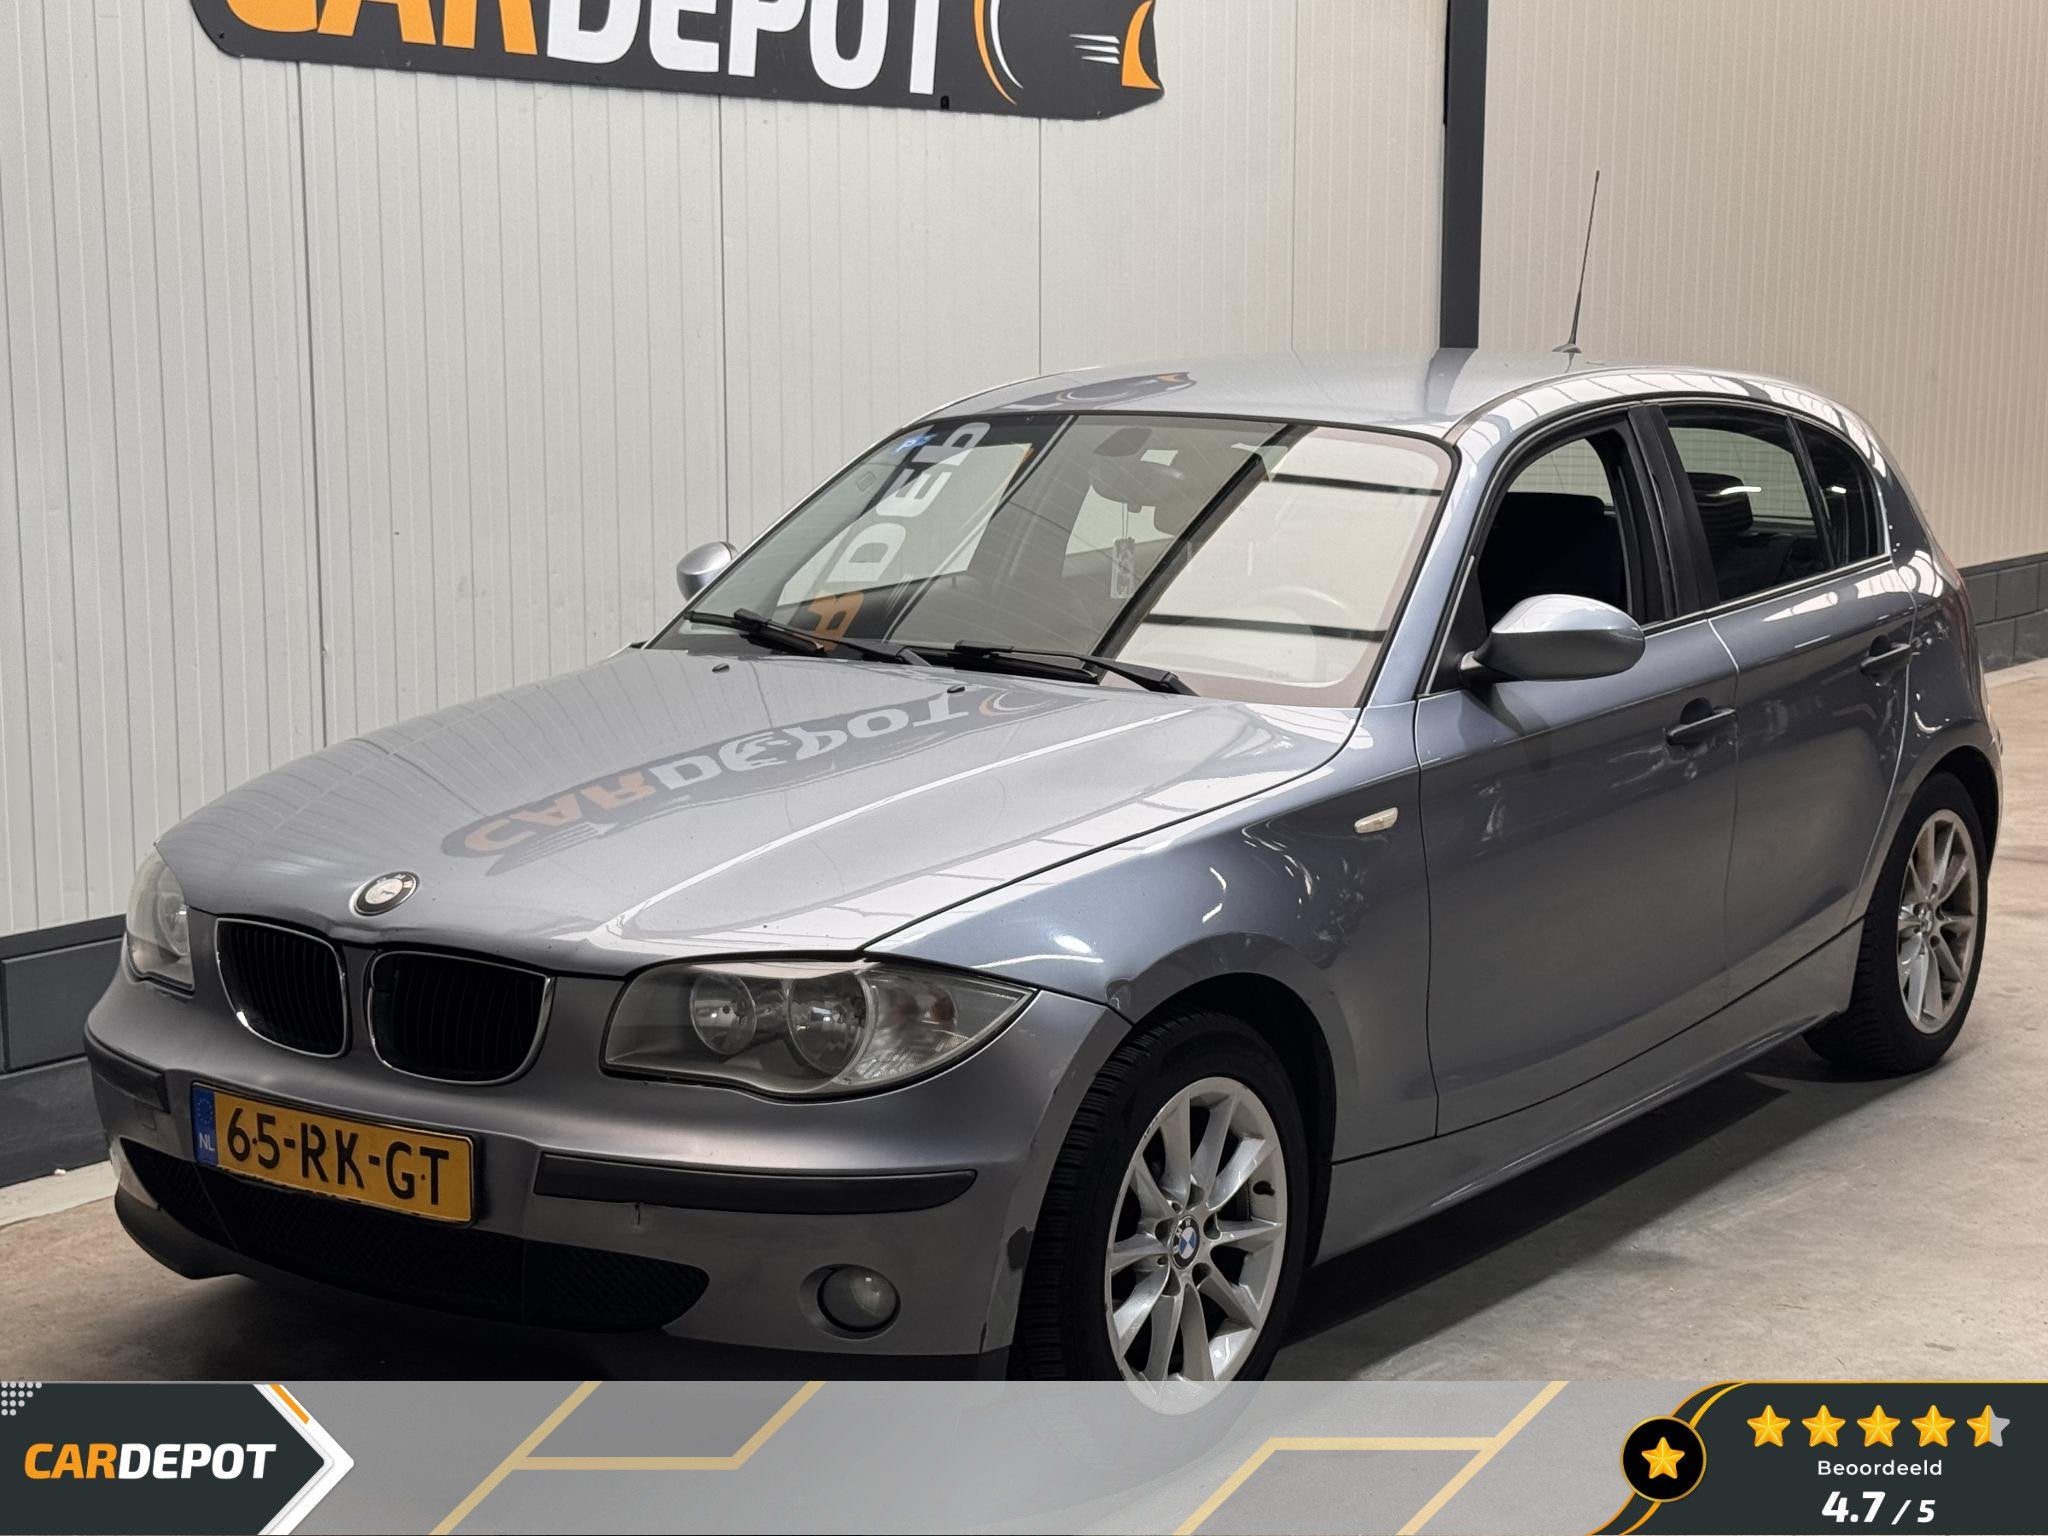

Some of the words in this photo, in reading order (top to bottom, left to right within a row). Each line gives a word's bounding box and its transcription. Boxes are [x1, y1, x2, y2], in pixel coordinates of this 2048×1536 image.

[226, 0, 939, 95] EPOT
[199, 1132, 214, 1151] NL
[227, 1108, 449, 1205] 65-RK-GT
